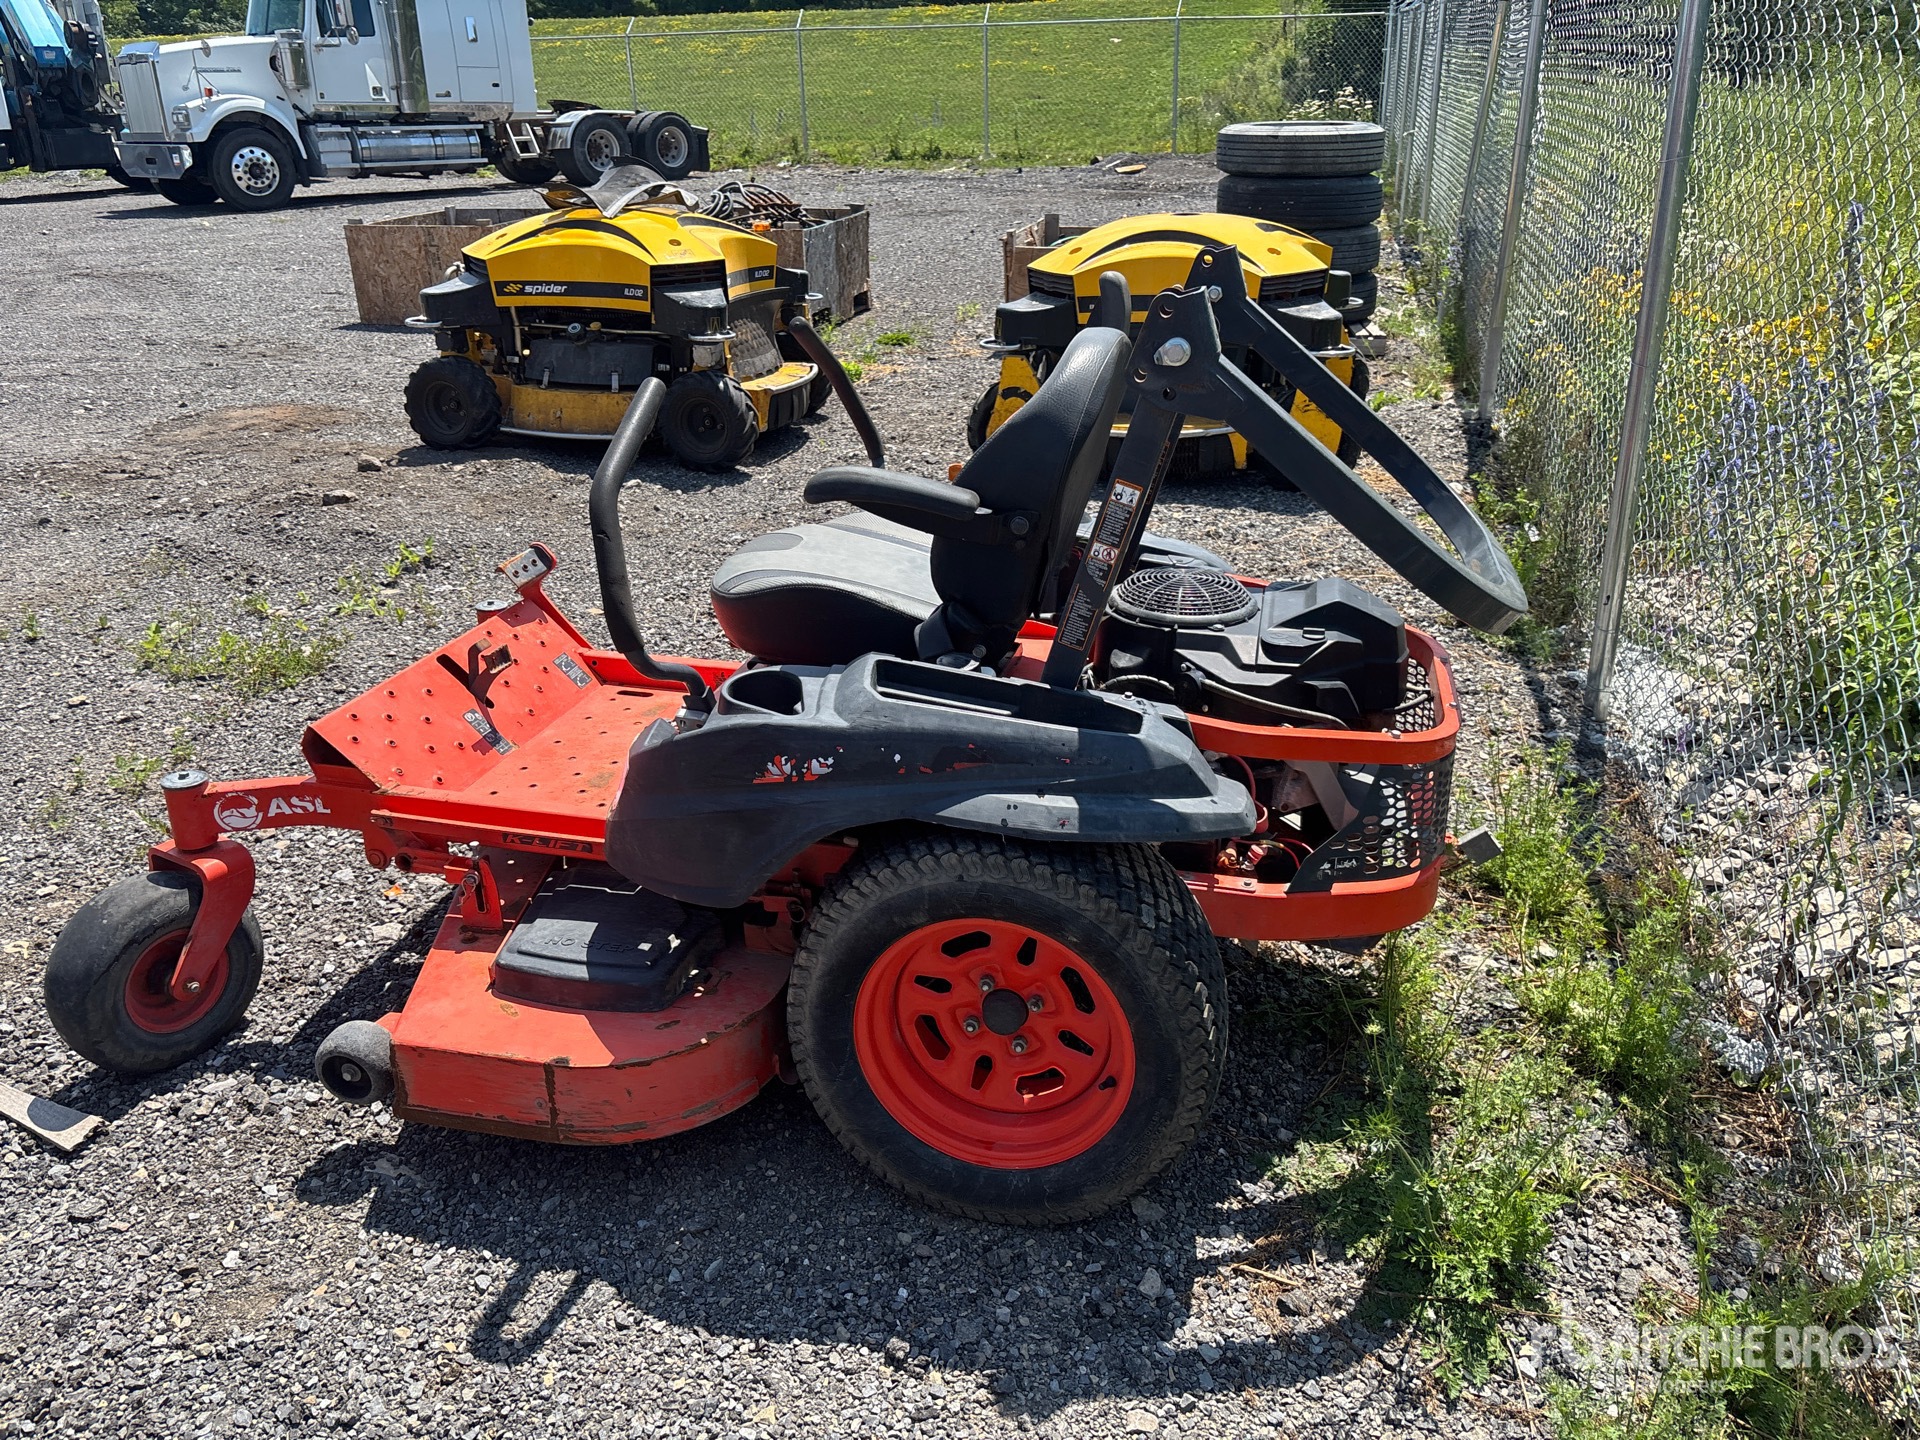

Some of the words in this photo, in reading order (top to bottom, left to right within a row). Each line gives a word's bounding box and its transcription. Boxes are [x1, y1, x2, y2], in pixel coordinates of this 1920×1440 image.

[524, 283, 567, 295] spider
[267, 796, 331, 817] ASL
[506, 834, 588, 852] K-LIFT
[544, 936, 576, 946] NO
[581, 941, 635, 953] STEP
